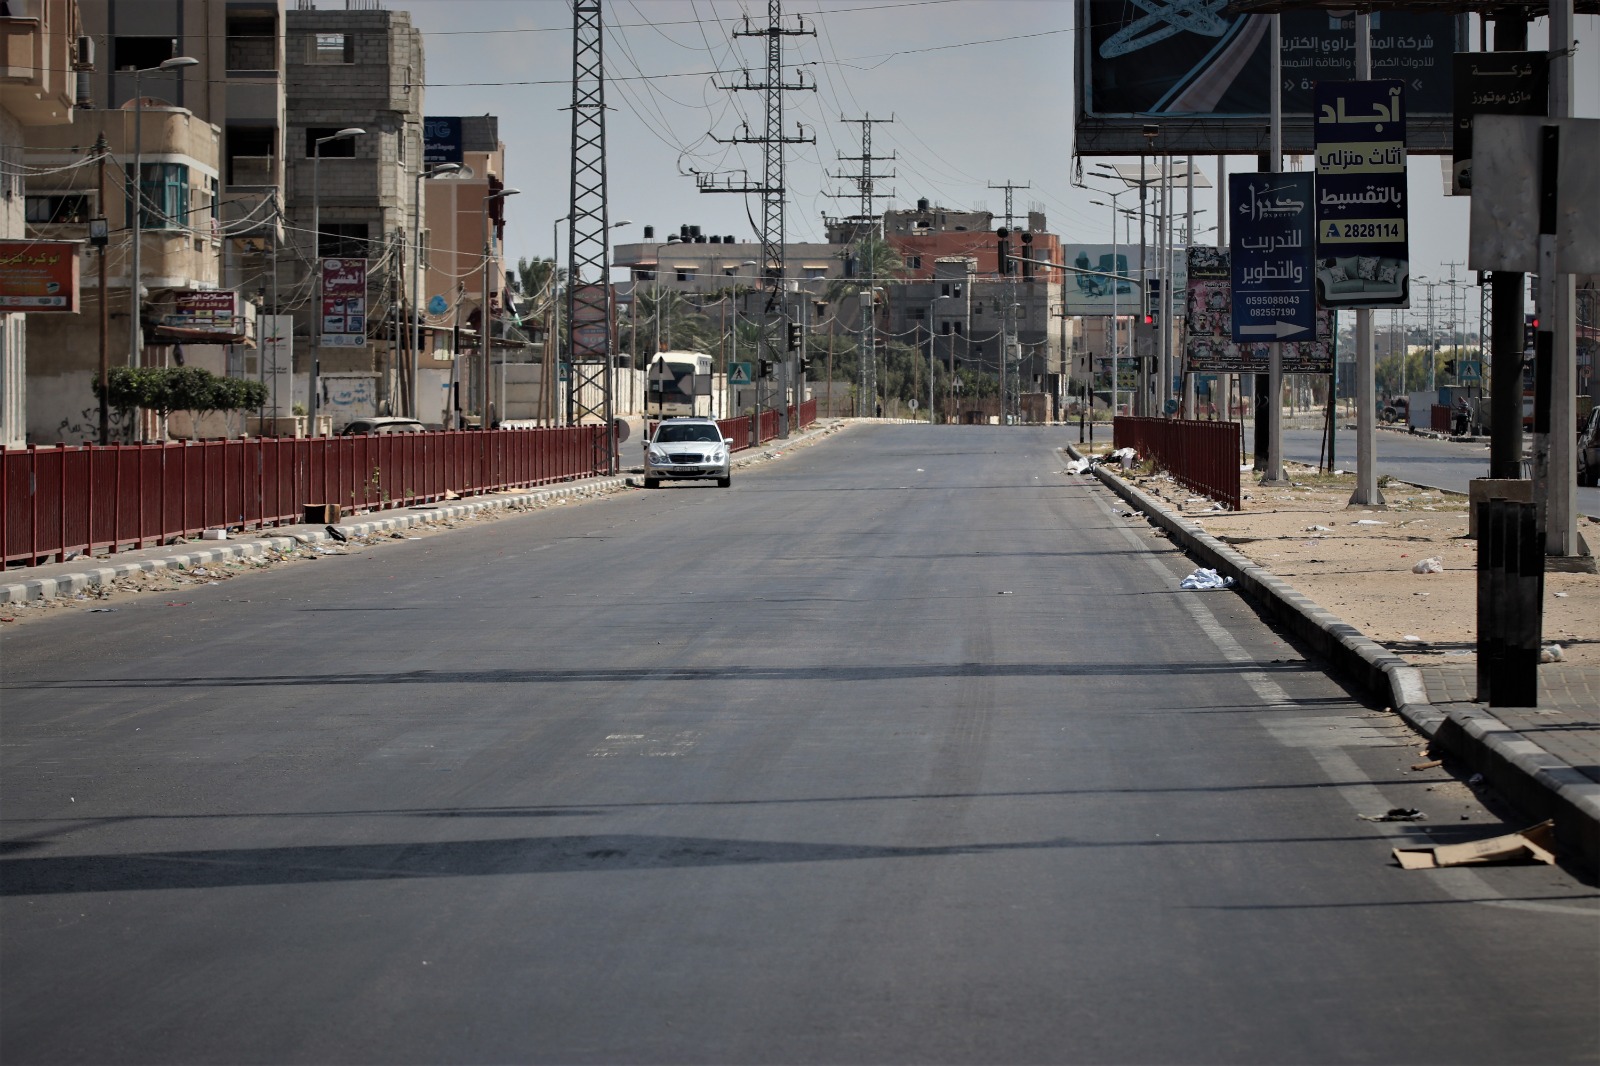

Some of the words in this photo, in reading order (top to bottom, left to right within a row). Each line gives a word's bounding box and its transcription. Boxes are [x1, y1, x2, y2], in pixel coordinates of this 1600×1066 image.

[1321, 34, 1394, 54] المشراوي
[1397, 34, 1434, 50] شركة
[1315, 57, 1351, 69] والطاقة
[1401, 56, 1435, 68] للأدوات
[1471, 63, 1532, 78] شركة
[1471, 90, 1506, 105] موتورز
[1507, 90, 1532, 105] مازن
[1318, 86, 1402, 133] آجاد
[1319, 149, 1364, 170] منزلي
[1368, 147, 1401, 166] أثاث
[1320, 185, 1402, 210] بالتقسيط
[1344, 223, 1399, 238] 2828114
[1241, 229, 1302, 254] للتدريب
[1241, 260, 1303, 284] والتطوير
[1245, 295, 1300, 306] 0595088043
[1250, 307, 1296, 317] 082557190
